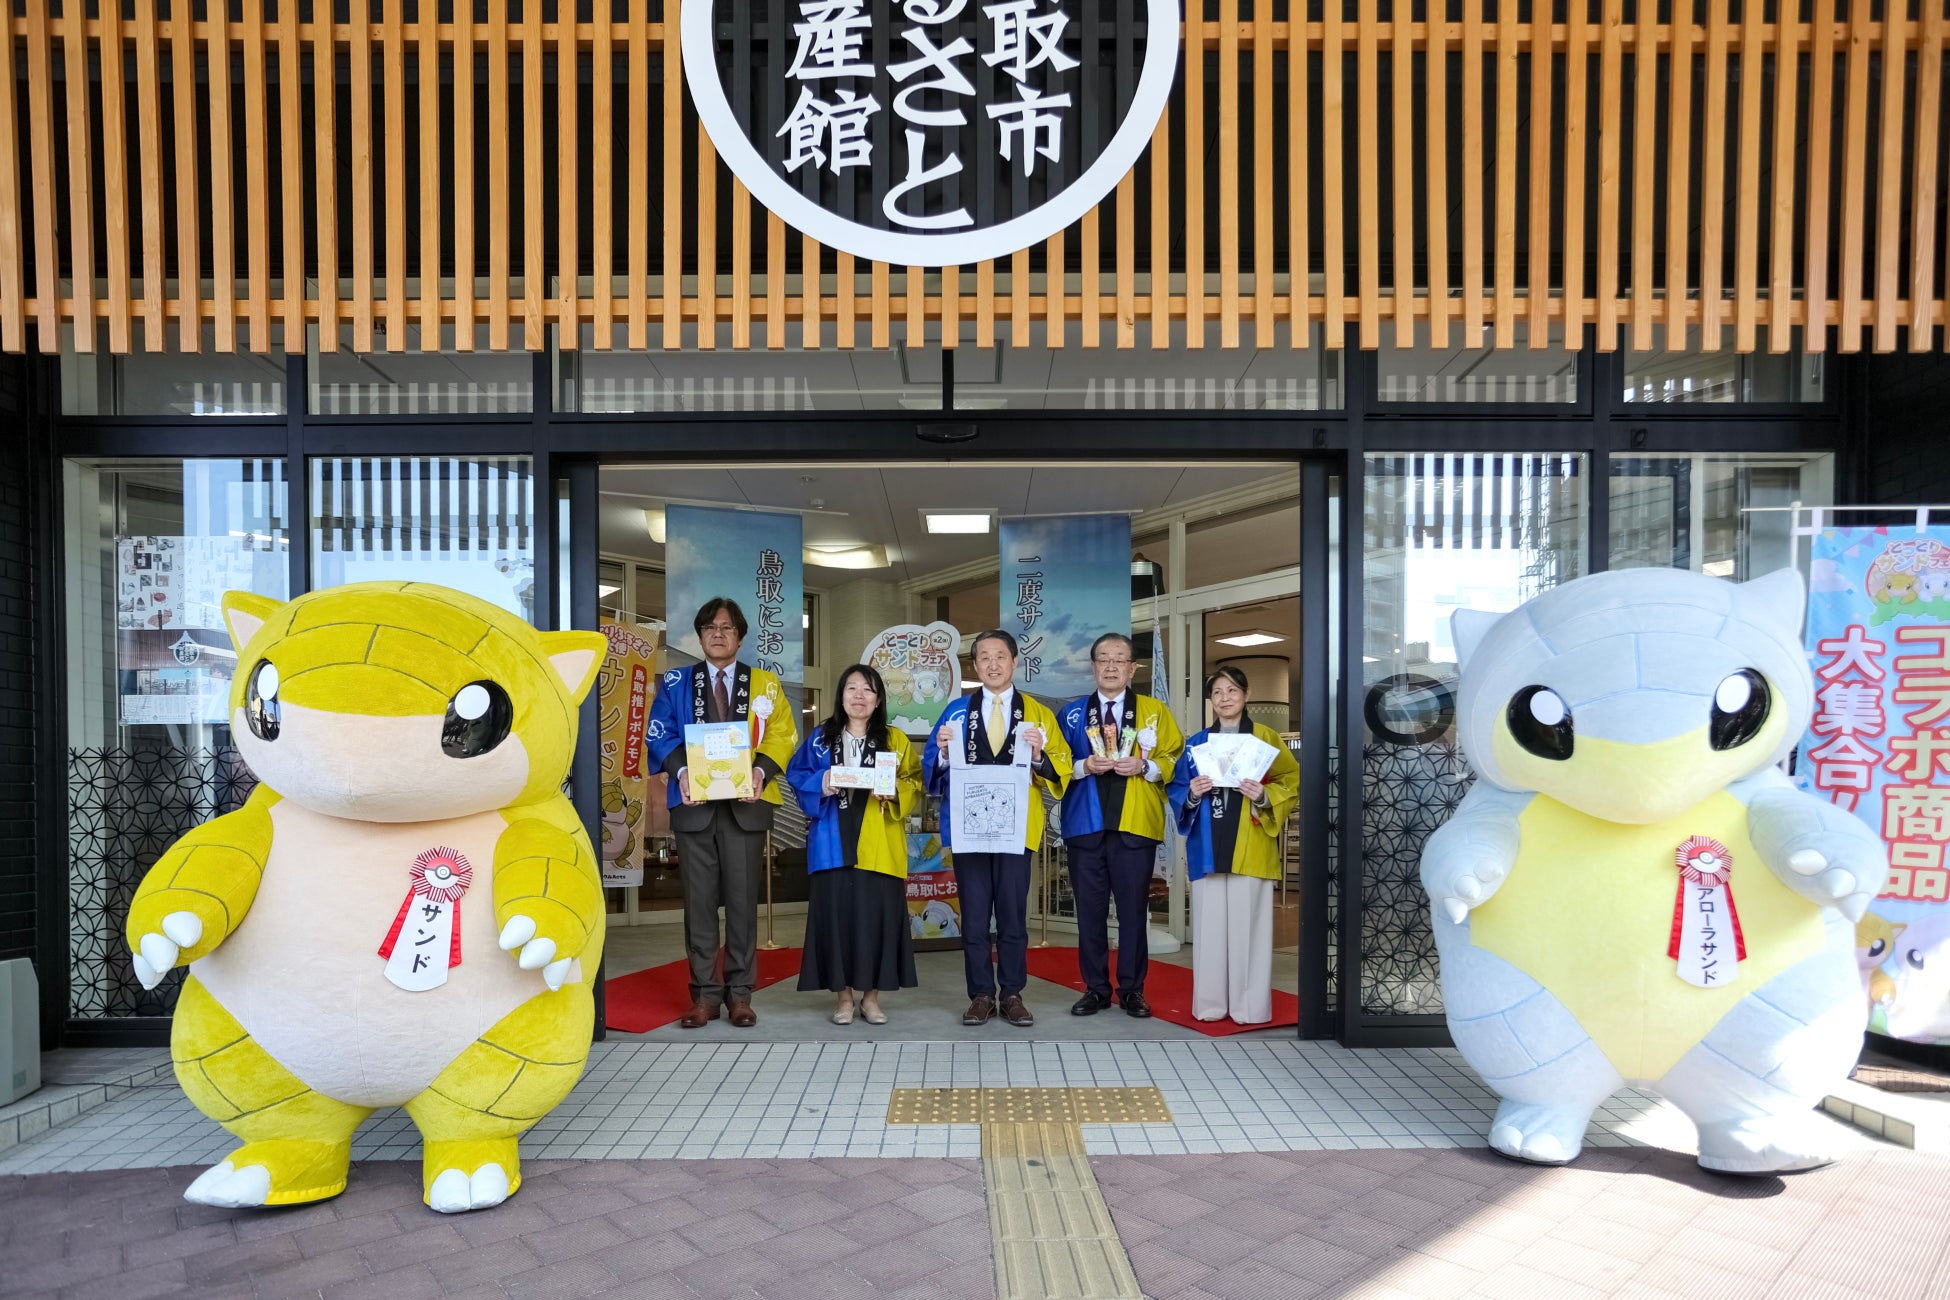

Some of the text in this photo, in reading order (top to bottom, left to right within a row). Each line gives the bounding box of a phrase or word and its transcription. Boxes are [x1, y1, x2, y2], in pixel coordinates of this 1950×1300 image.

[756, 549, 785, 676] 鳥取におい
[883, 633, 930, 650] とっとり
[1015, 555, 1043, 683] 二度サンド
[736, 673, 748, 714] さんど
[875, 649, 948, 669] サンドフェア
[624, 669, 645, 772] 鳥取推しポケモン
[905, 880, 958, 898] 鳥取にお
[411, 903, 442, 973] サンド
[1697, 887, 1718, 985] アローラサンド
